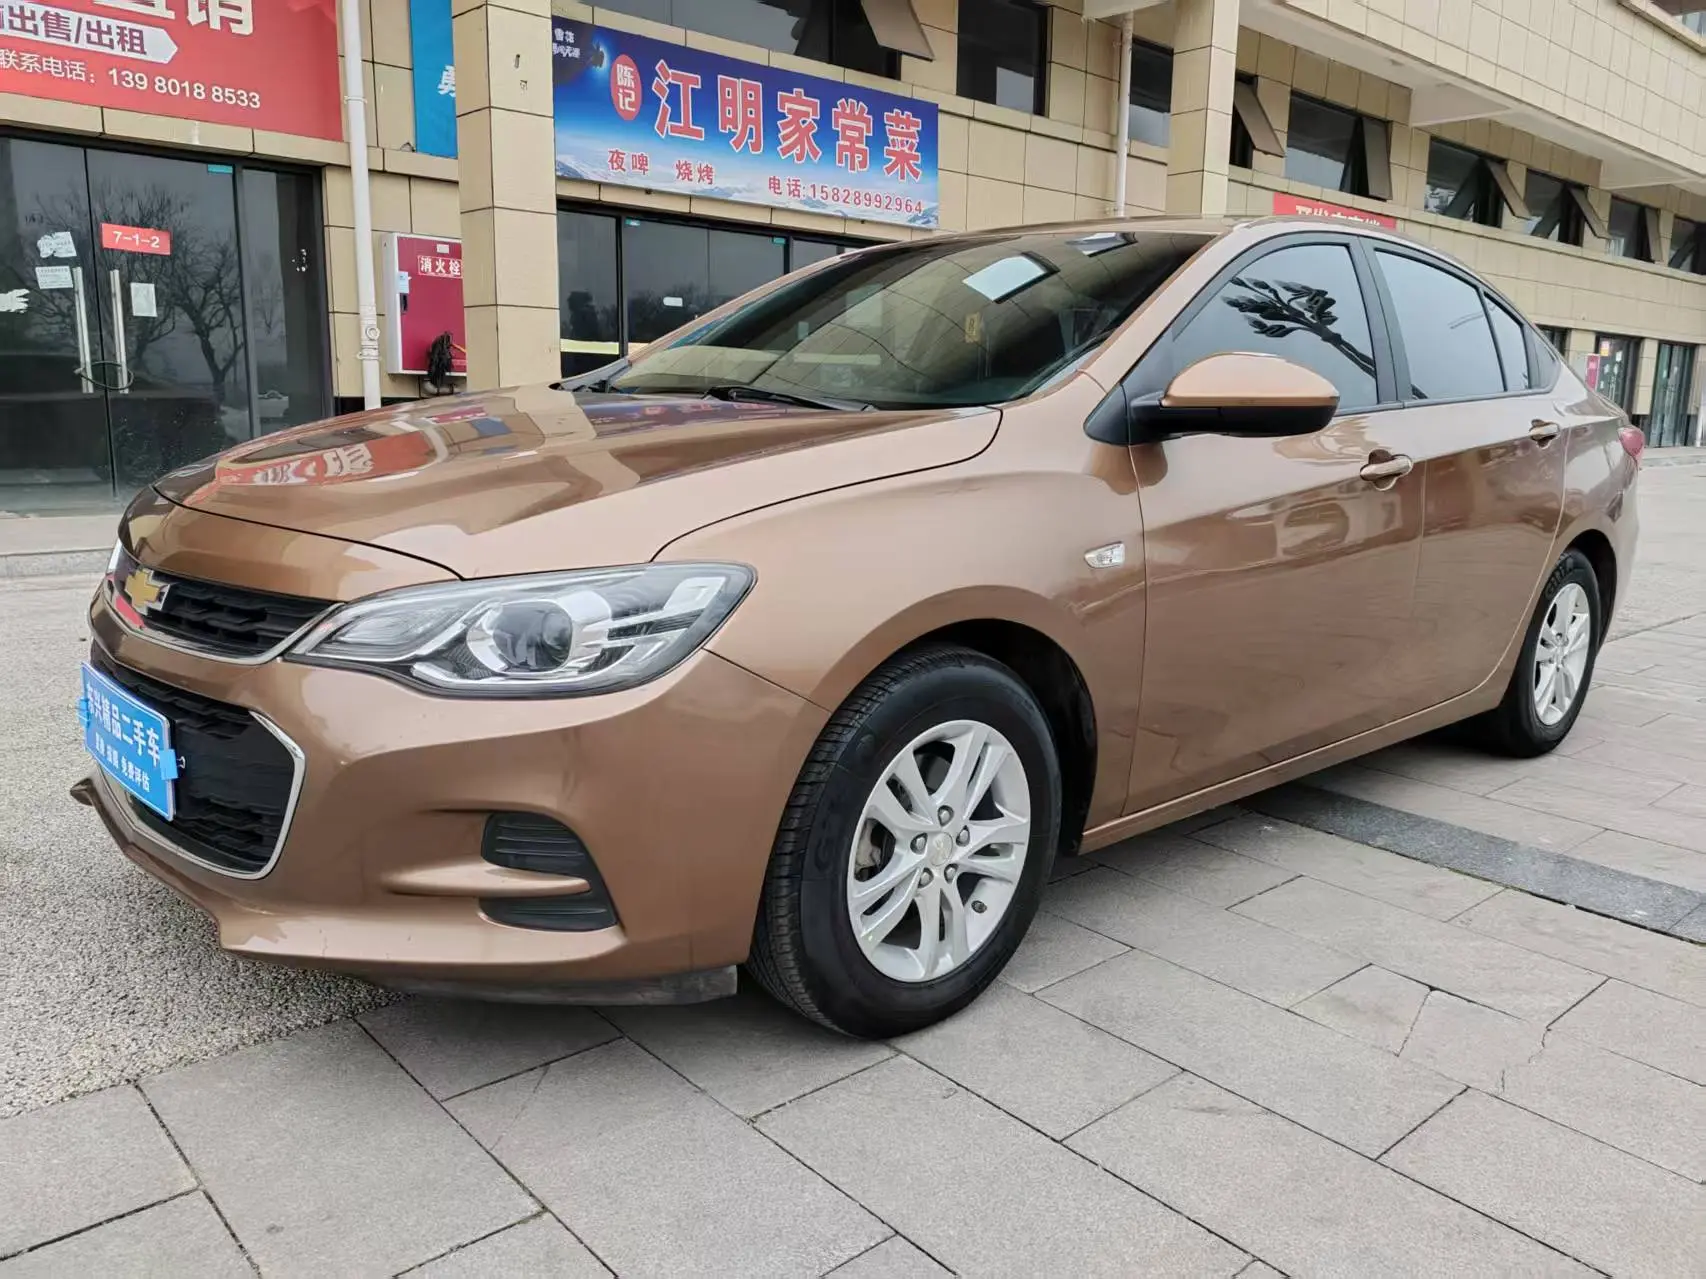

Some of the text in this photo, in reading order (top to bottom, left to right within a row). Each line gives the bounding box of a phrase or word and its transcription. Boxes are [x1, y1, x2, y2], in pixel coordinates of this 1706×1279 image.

[0, 4, 147, 55] 出售/出租
[108, 68, 148, 90] 139
[154, 76, 206, 100] 8018
[211, 86, 261, 109] 8533
[616, 63, 636, 112] 陈记
[651, 59, 922, 182] 江明家常菜
[608, 149, 714, 185] 夜啤 烧烤
[112, 230, 161, 249] 7-1-2
[420, 256, 461, 276] 消火栓
